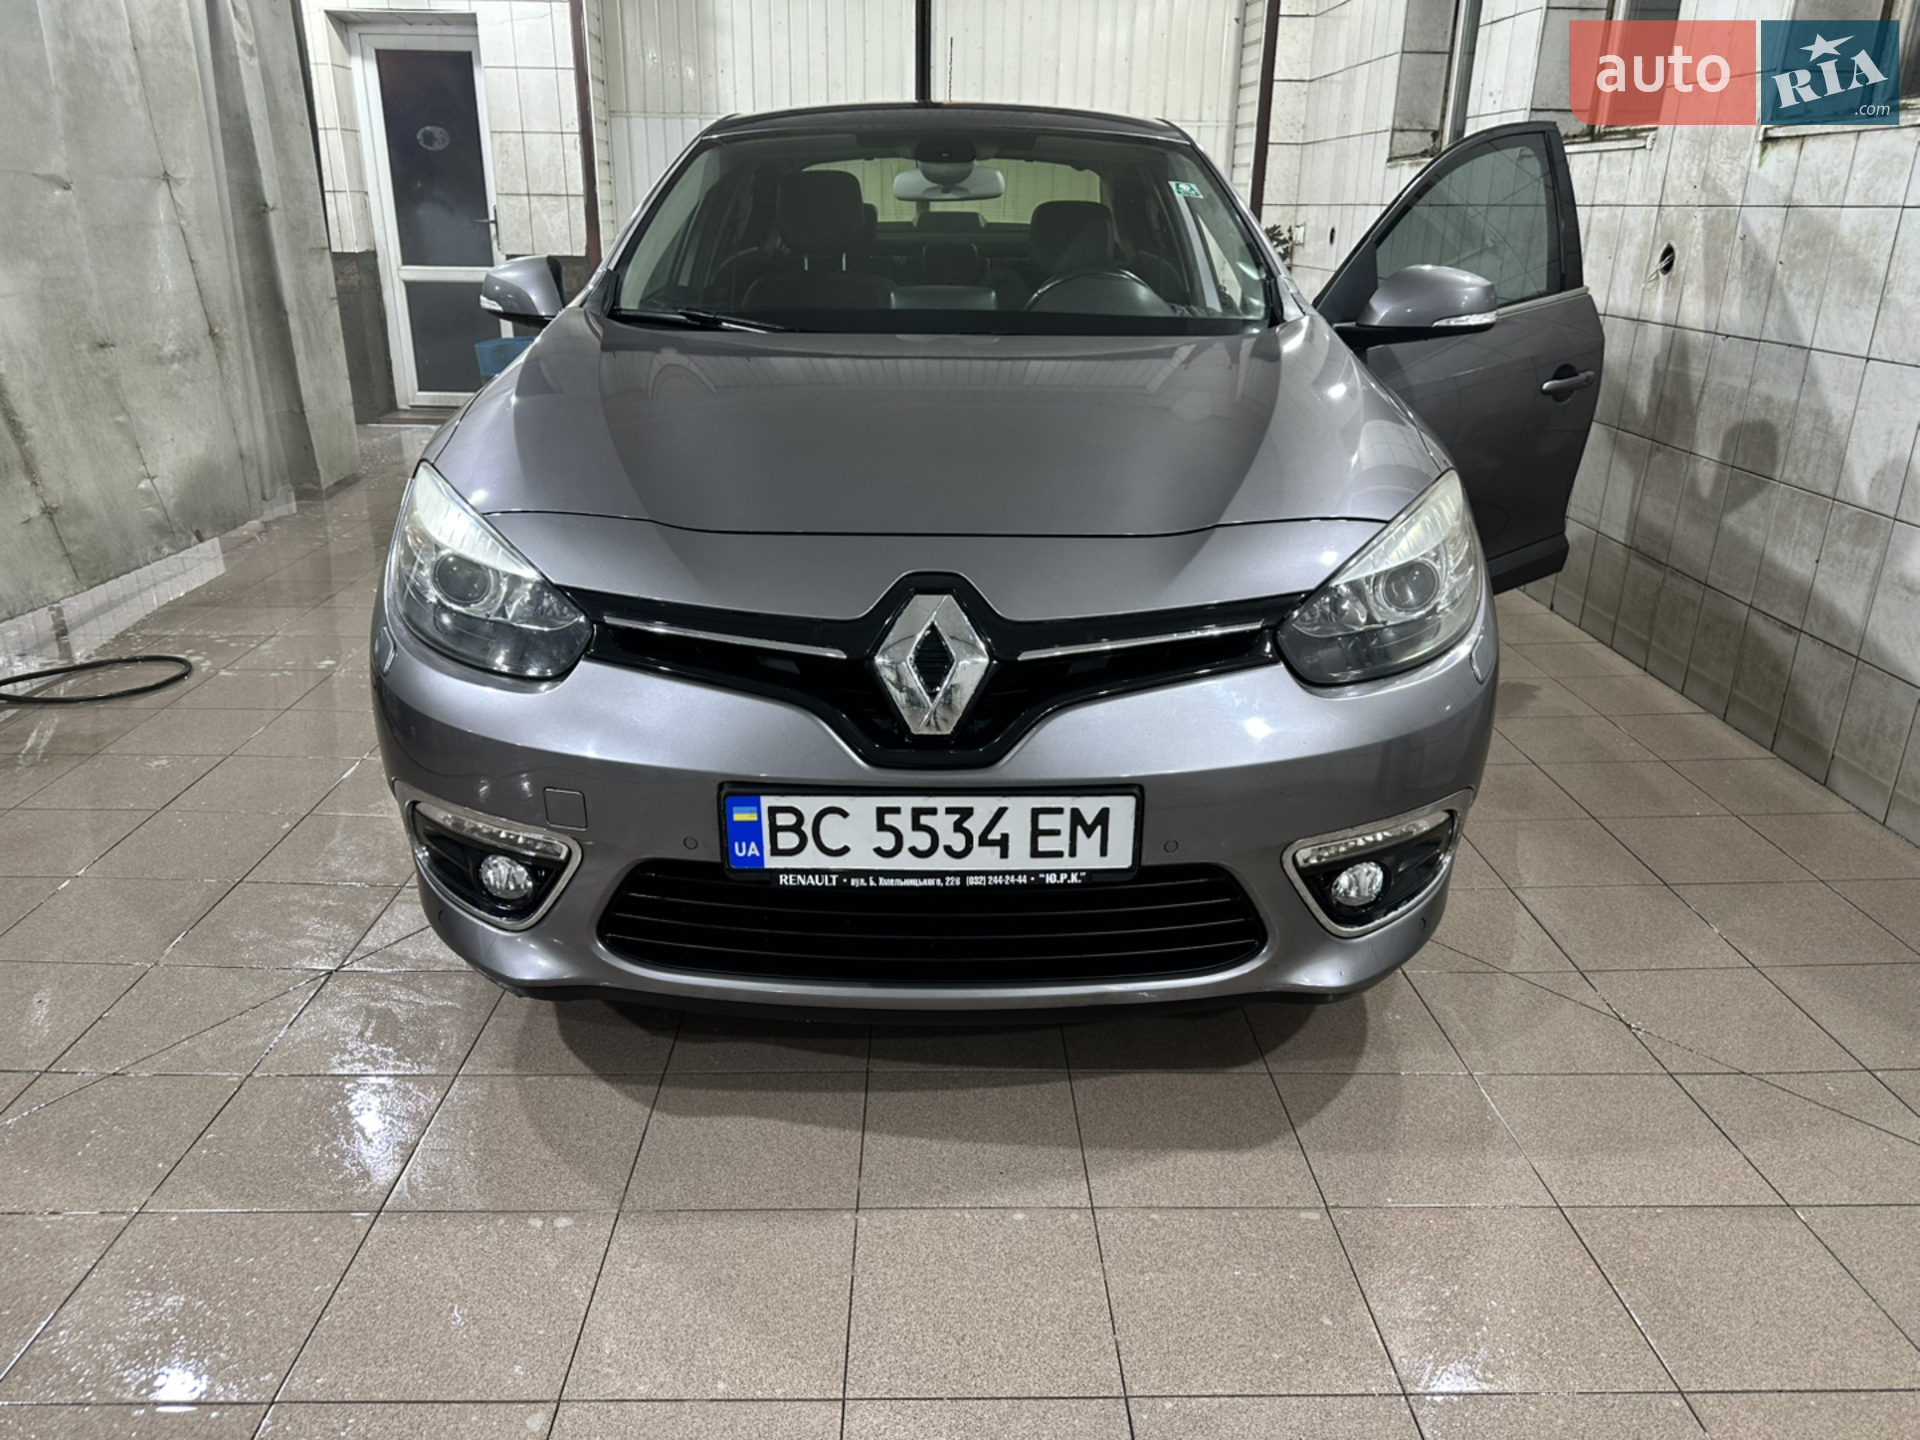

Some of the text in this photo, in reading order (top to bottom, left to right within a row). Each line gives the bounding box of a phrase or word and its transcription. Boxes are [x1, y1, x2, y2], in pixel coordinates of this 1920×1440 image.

[767, 806, 1110, 860] BC 5534 EM
[733, 841, 760, 858] UA
[779, 874, 839, 886] RENAULT
[966, 876, 986, 886] (032)
[988, 874, 1028, 885] 244-24-44
